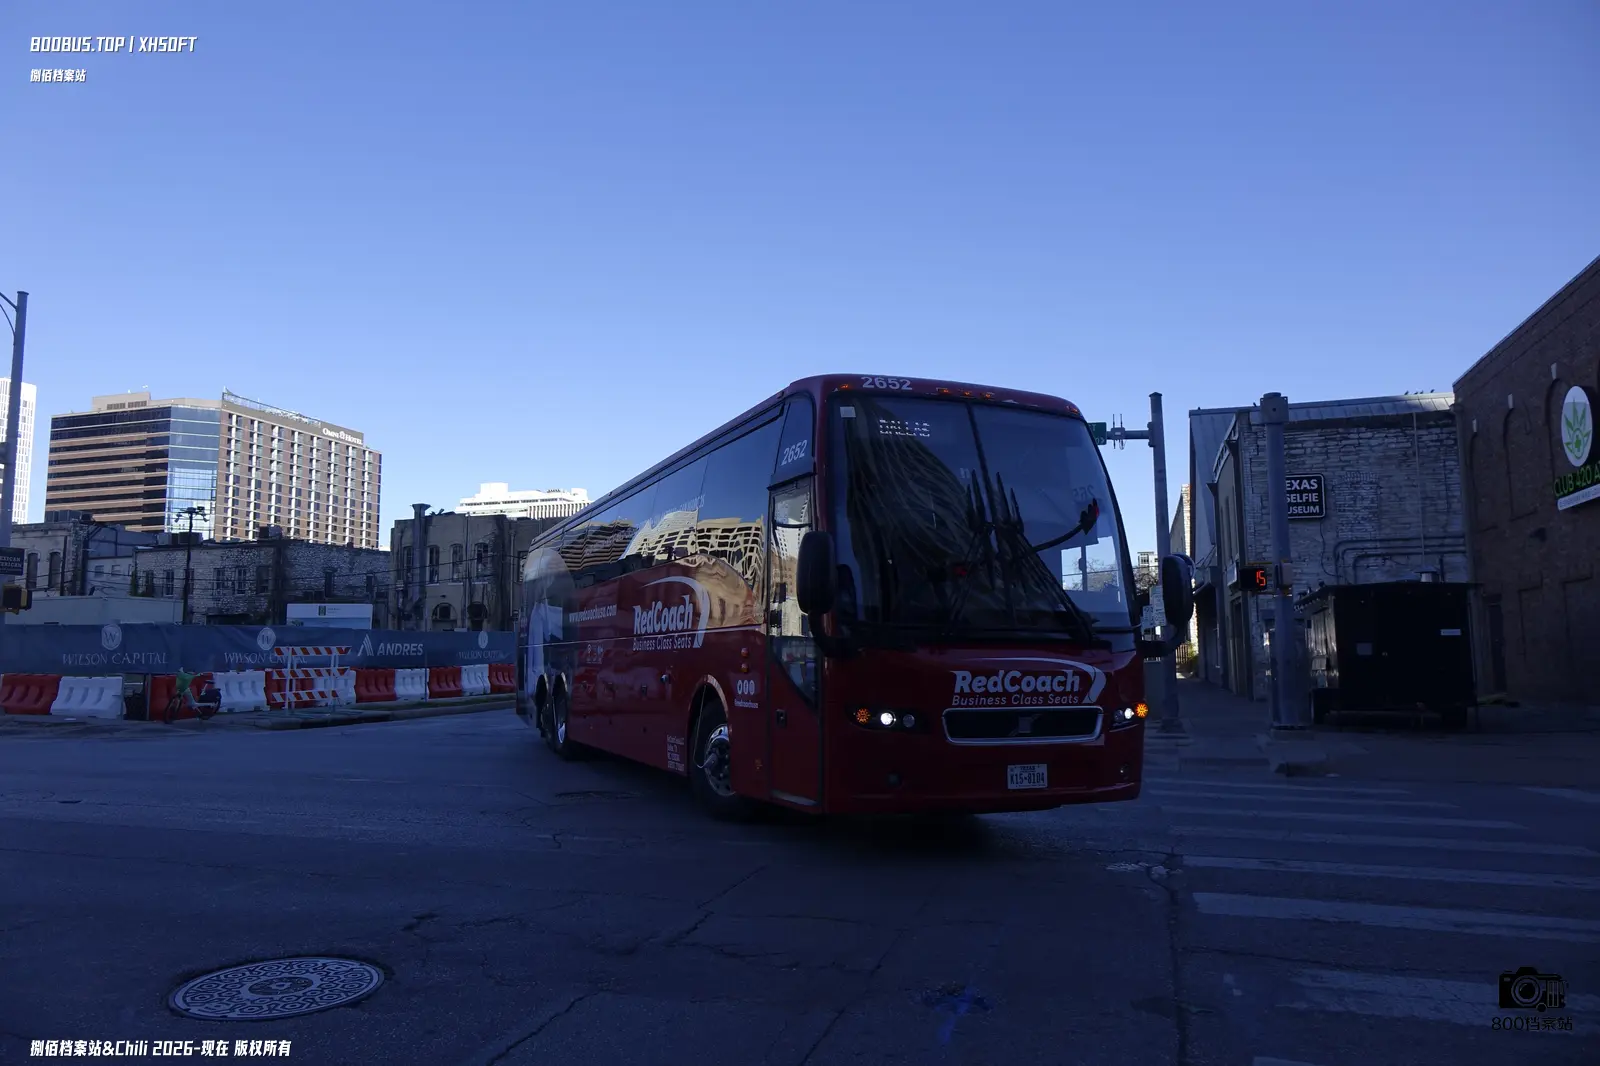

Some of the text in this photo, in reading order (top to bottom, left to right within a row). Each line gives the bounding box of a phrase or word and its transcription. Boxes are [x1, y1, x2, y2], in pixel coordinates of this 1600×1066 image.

[860, 376, 913, 391] 2652
[879, 419, 931, 438] DALLAS
[780, 439, 808, 467] 2652
[1285, 479, 1318, 491] EXAS
[1554, 474, 1573, 496] CLUB
[1573, 466, 1592, 487] 420
[1287, 492, 1319, 504] SELFIE
[1288, 505, 1320, 515] USEUM
[1255, 568, 1267, 588] 15
[632, 594, 694, 635] RedCoach
[377, 643, 424, 657] ANDRES
[633, 635, 692, 652] Business Class Seats
[62, 652, 168, 666] WILSON CAPITAL
[224, 652, 266, 664] WILSON
[950, 670, 1081, 693] RedCoach
[951, 693, 1079, 706] Business Class Seats
